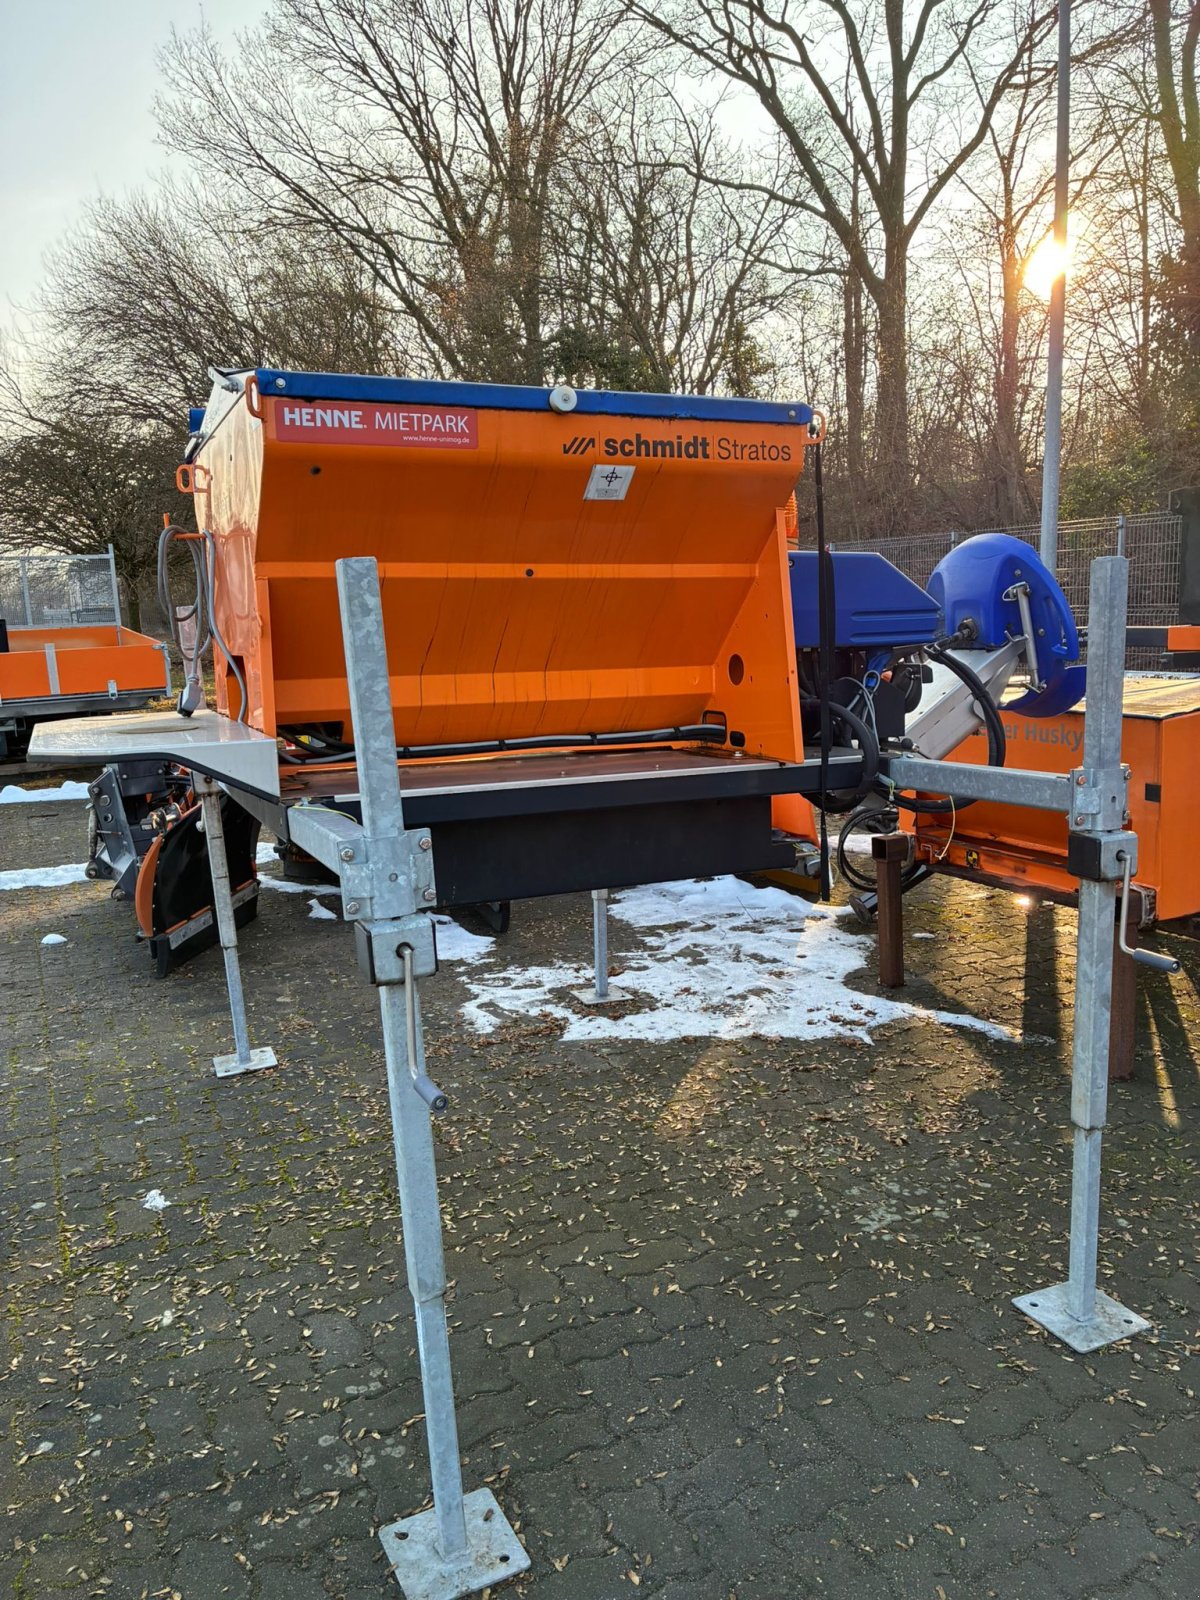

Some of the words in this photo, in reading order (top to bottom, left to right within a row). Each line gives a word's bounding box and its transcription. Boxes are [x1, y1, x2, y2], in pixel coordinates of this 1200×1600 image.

[375, 411, 470, 433] MIETPARK
[403, 434, 470, 445] www.henne-unimog.de
[604, 433, 710, 459] schmidt
[717, 437, 792, 461] Stratos
[1024, 721, 1083, 752] Husky
